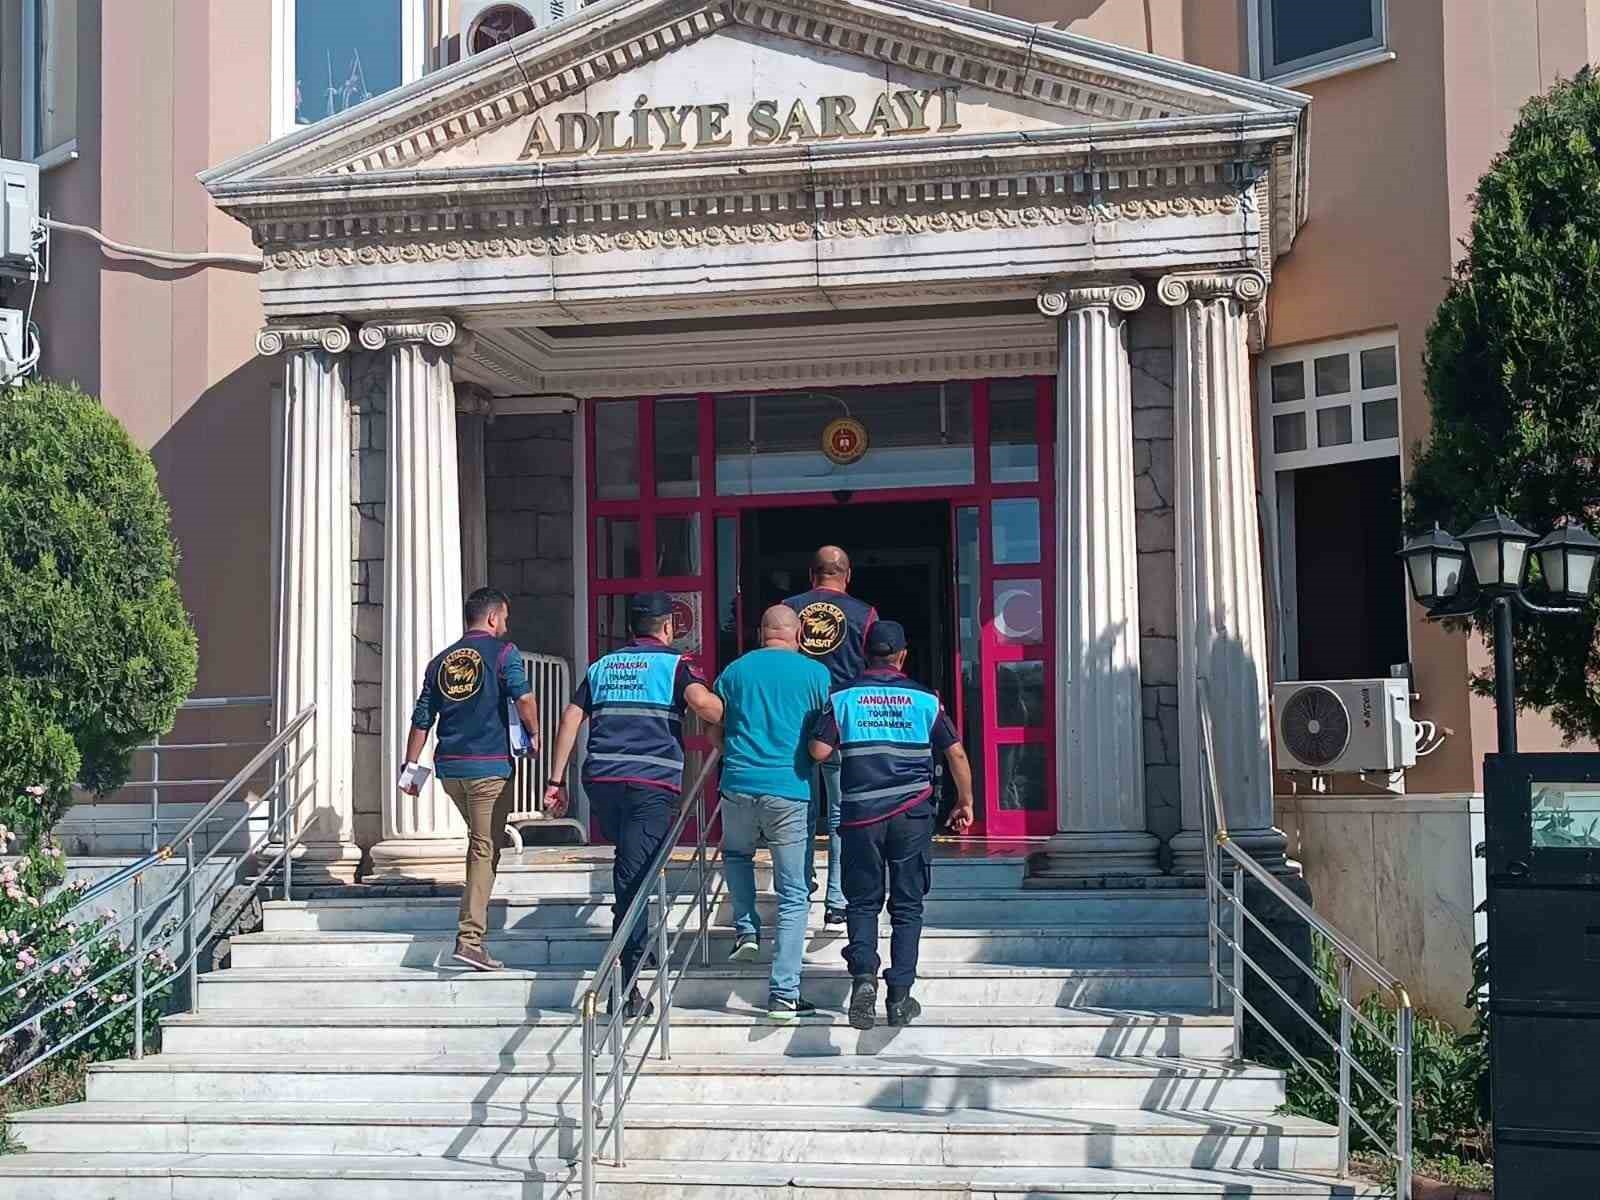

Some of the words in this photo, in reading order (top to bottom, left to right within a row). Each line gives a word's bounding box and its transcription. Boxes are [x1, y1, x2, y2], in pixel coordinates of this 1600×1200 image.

[518, 93, 733, 161] ADLİYE
[747, 87, 963, 147] SARAYI
[857, 695, 912, 705] JANDARMA
